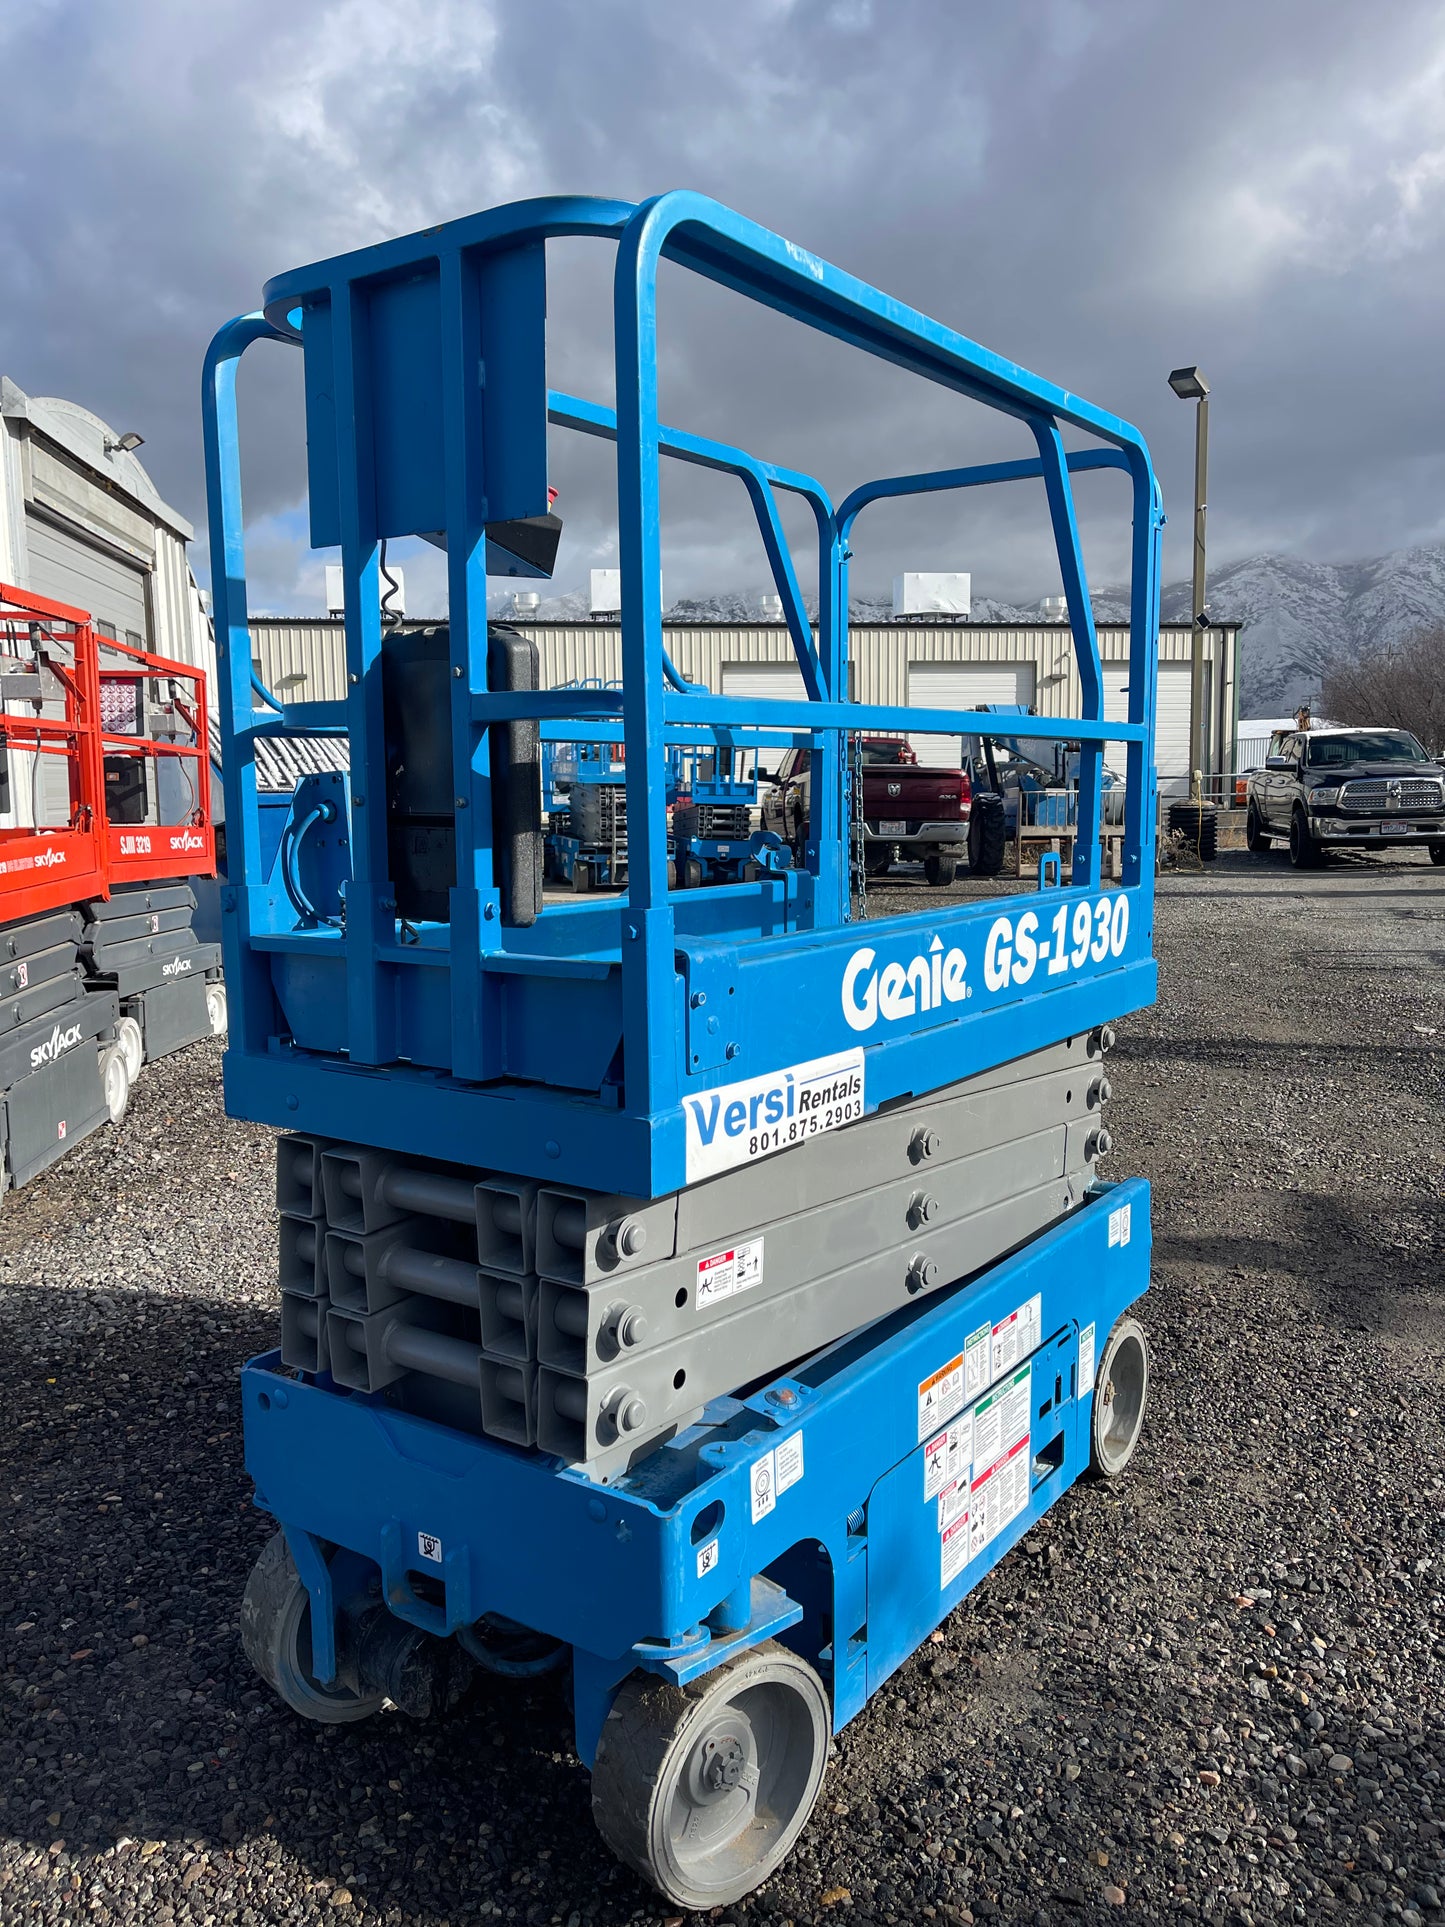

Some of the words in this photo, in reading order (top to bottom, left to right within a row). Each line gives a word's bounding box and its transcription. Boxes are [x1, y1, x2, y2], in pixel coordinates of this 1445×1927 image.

[34, 848, 66, 867] SKYJACK
[135, 836, 152, 854] 3219
[169, 830, 204, 852] SKYJACK
[162, 956, 192, 976] SKYJACK
[842, 934, 968, 1031] Genie
[983, 893, 1130, 992] GS-1930
[30, 1023, 83, 1068] SKYJACK
[689, 1073, 795, 1147] Versi
[799, 1075, 862, 1114] Rentals
[749, 1100, 862, 1155] 801.875.2903
